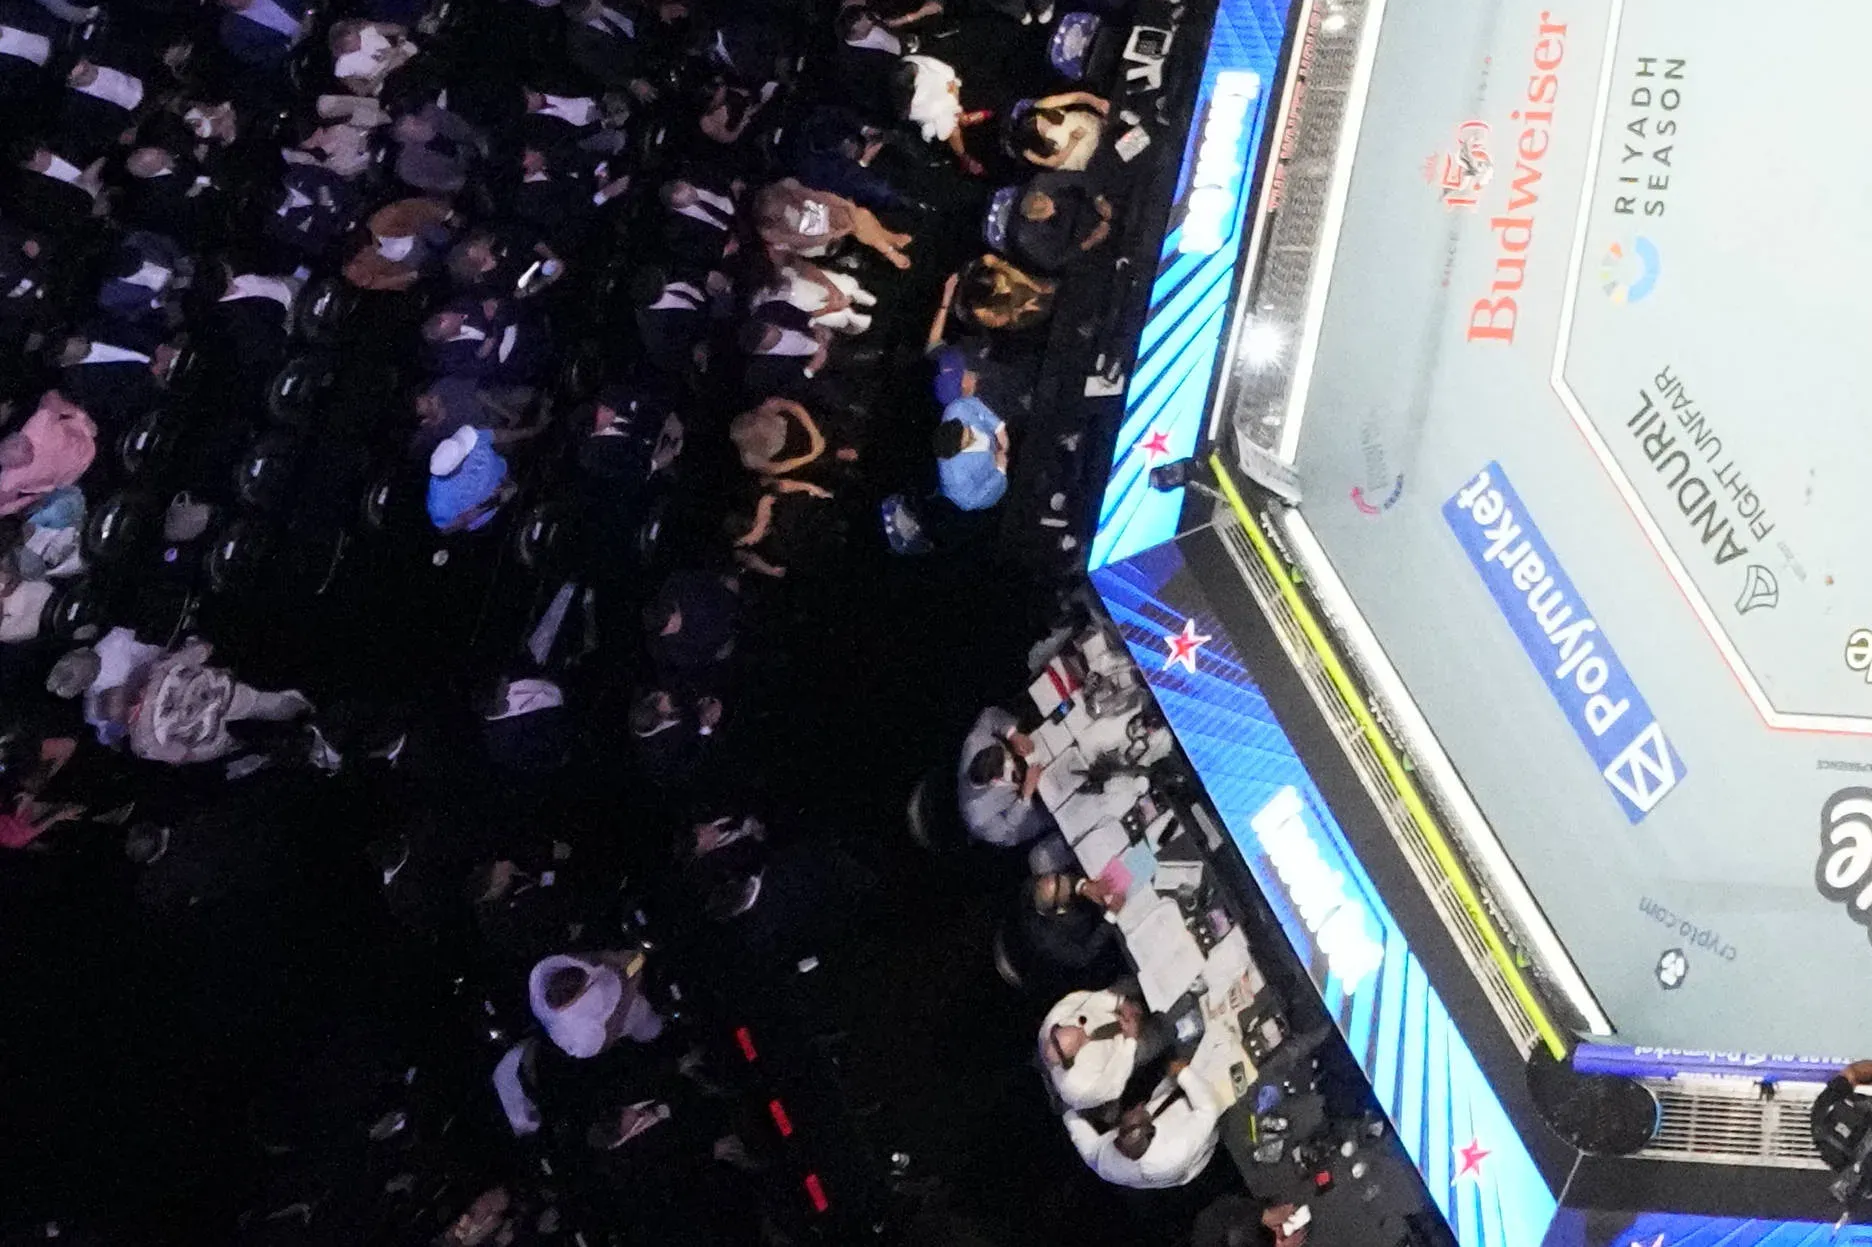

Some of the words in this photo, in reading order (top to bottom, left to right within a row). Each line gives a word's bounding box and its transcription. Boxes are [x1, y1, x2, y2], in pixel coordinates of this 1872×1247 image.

[1467, 11, 1568, 345] Budweiser
[1615, 56, 1659, 214] RIYADH
[1644, 58, 1687, 217] SEASON
[1627, 391, 1746, 565] ANDURIL
[1655, 365, 1727, 463] UNFAIR
[1713, 460, 1775, 542] FIGHT
[1456, 471, 1630, 737] Polymarket
[1638, 895, 1737, 961] crypto.com
